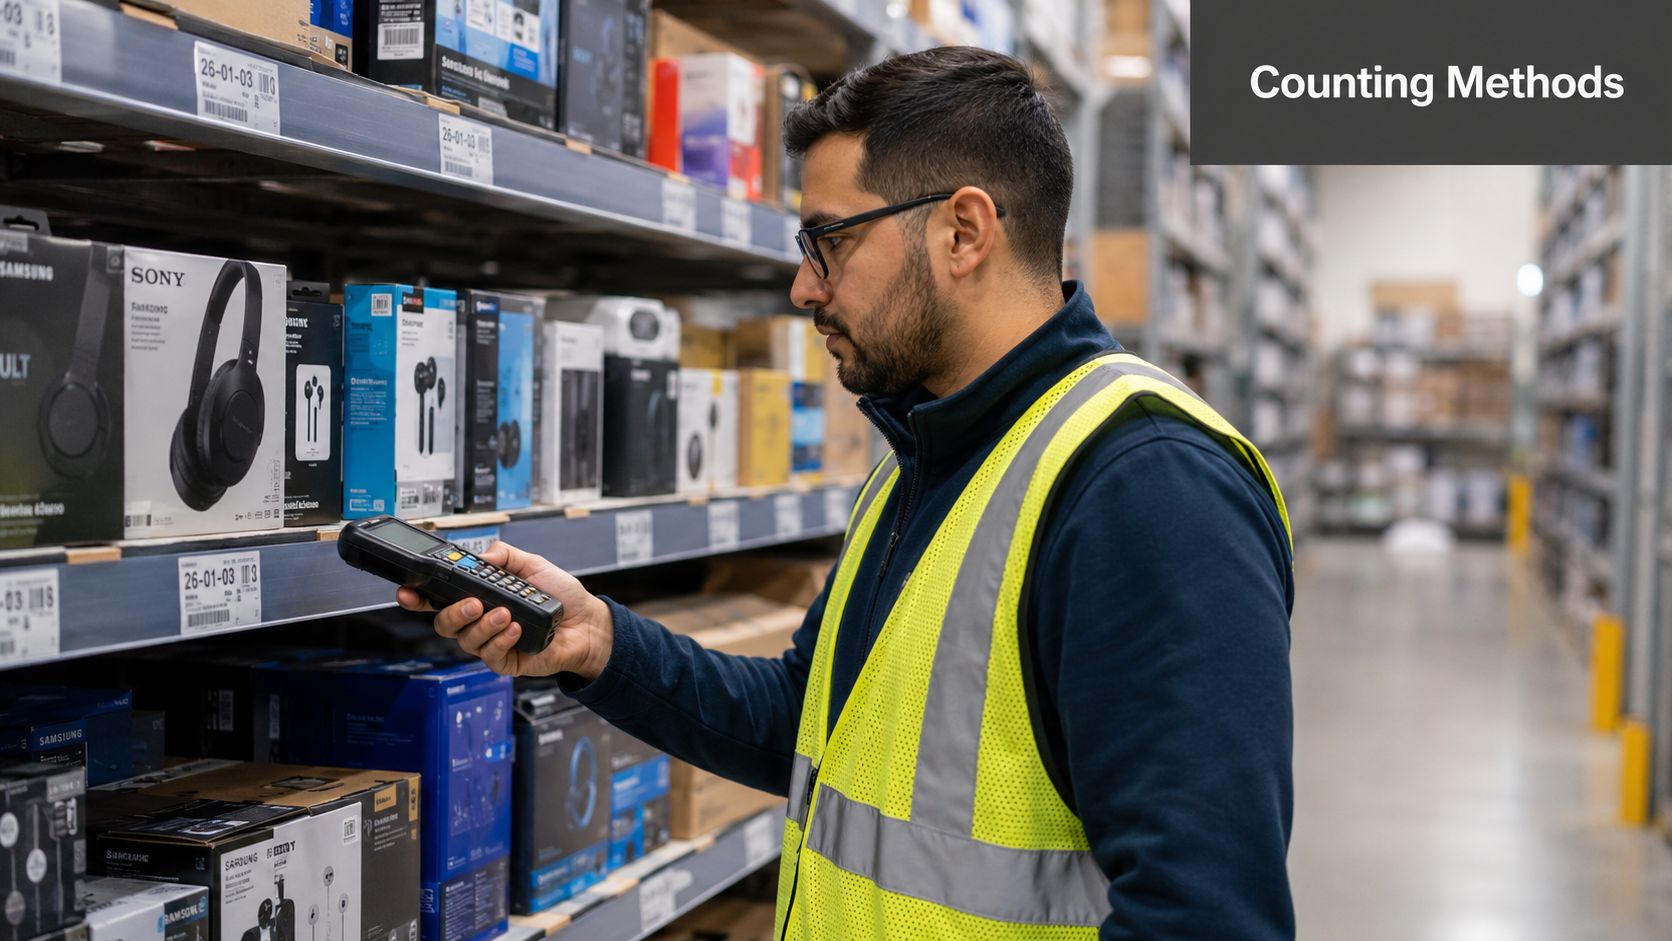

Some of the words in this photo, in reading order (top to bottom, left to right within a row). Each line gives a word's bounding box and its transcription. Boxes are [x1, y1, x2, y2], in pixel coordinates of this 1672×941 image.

[201, 58, 253, 89] 26-01-03
[131, 266, 185, 287] SONY
[0, 352, 31, 379] ULT
[184, 567, 235, 590] 26-01-03
